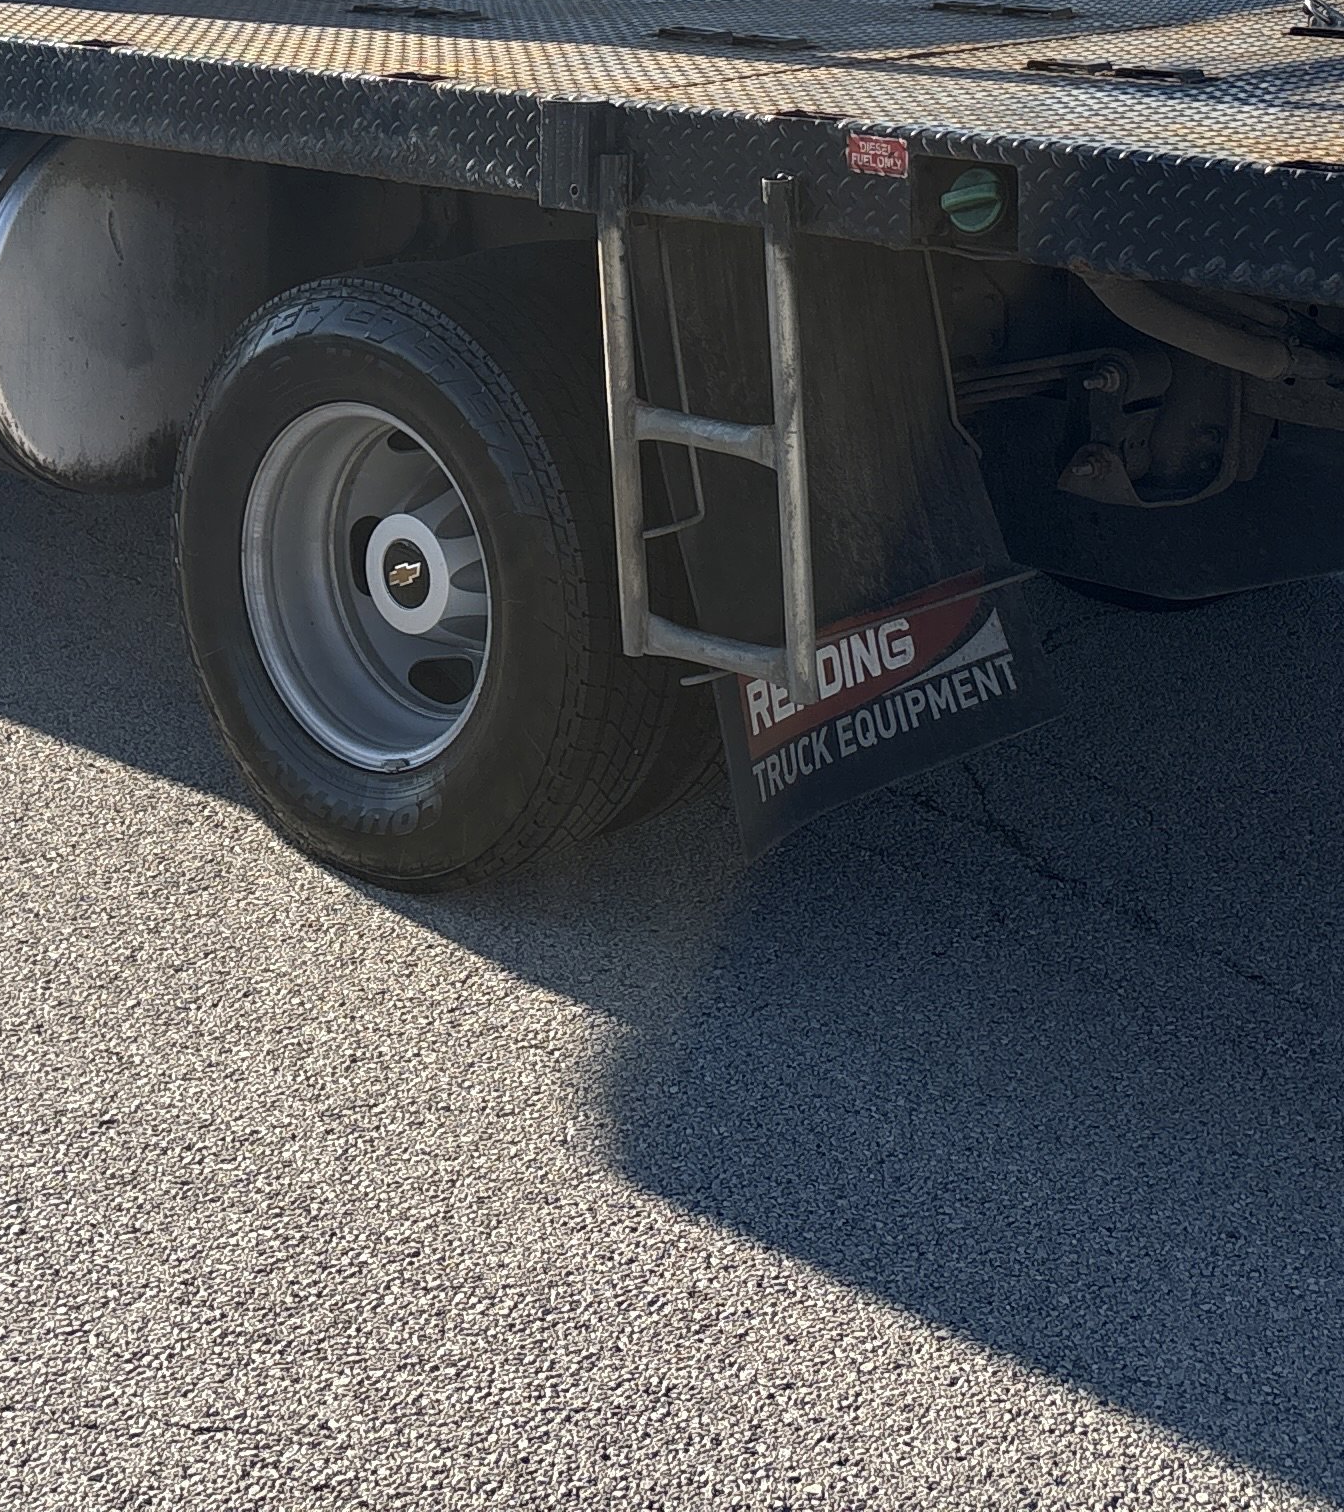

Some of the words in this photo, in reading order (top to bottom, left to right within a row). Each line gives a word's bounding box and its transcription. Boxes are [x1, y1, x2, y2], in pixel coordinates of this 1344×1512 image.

[851, 152, 876, 167] FUEL
[876, 156, 902, 169] ONLY
[746, 617, 915, 736] REDING
[752, 724, 834, 803] TRUCK
[837, 655, 1017, 758] EQUIPMENT
